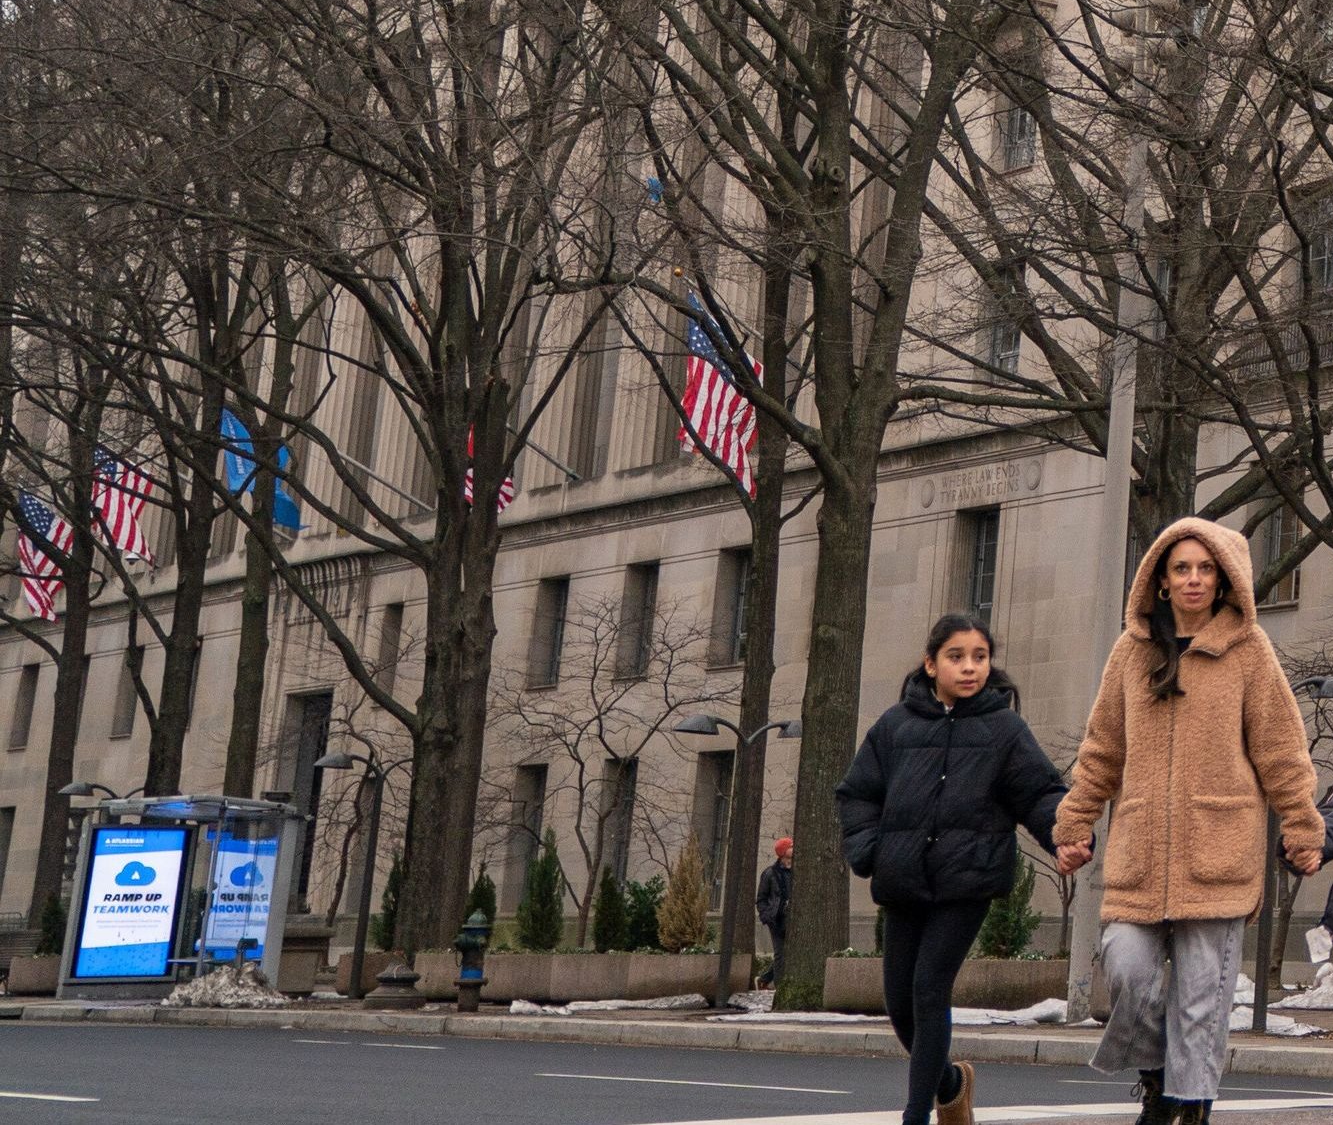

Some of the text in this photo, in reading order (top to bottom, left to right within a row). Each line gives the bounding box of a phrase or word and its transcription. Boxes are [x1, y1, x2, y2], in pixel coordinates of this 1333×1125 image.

[103, 893, 162, 902] RAMP UP
[93, 905, 170, 914] TEAMWORK
